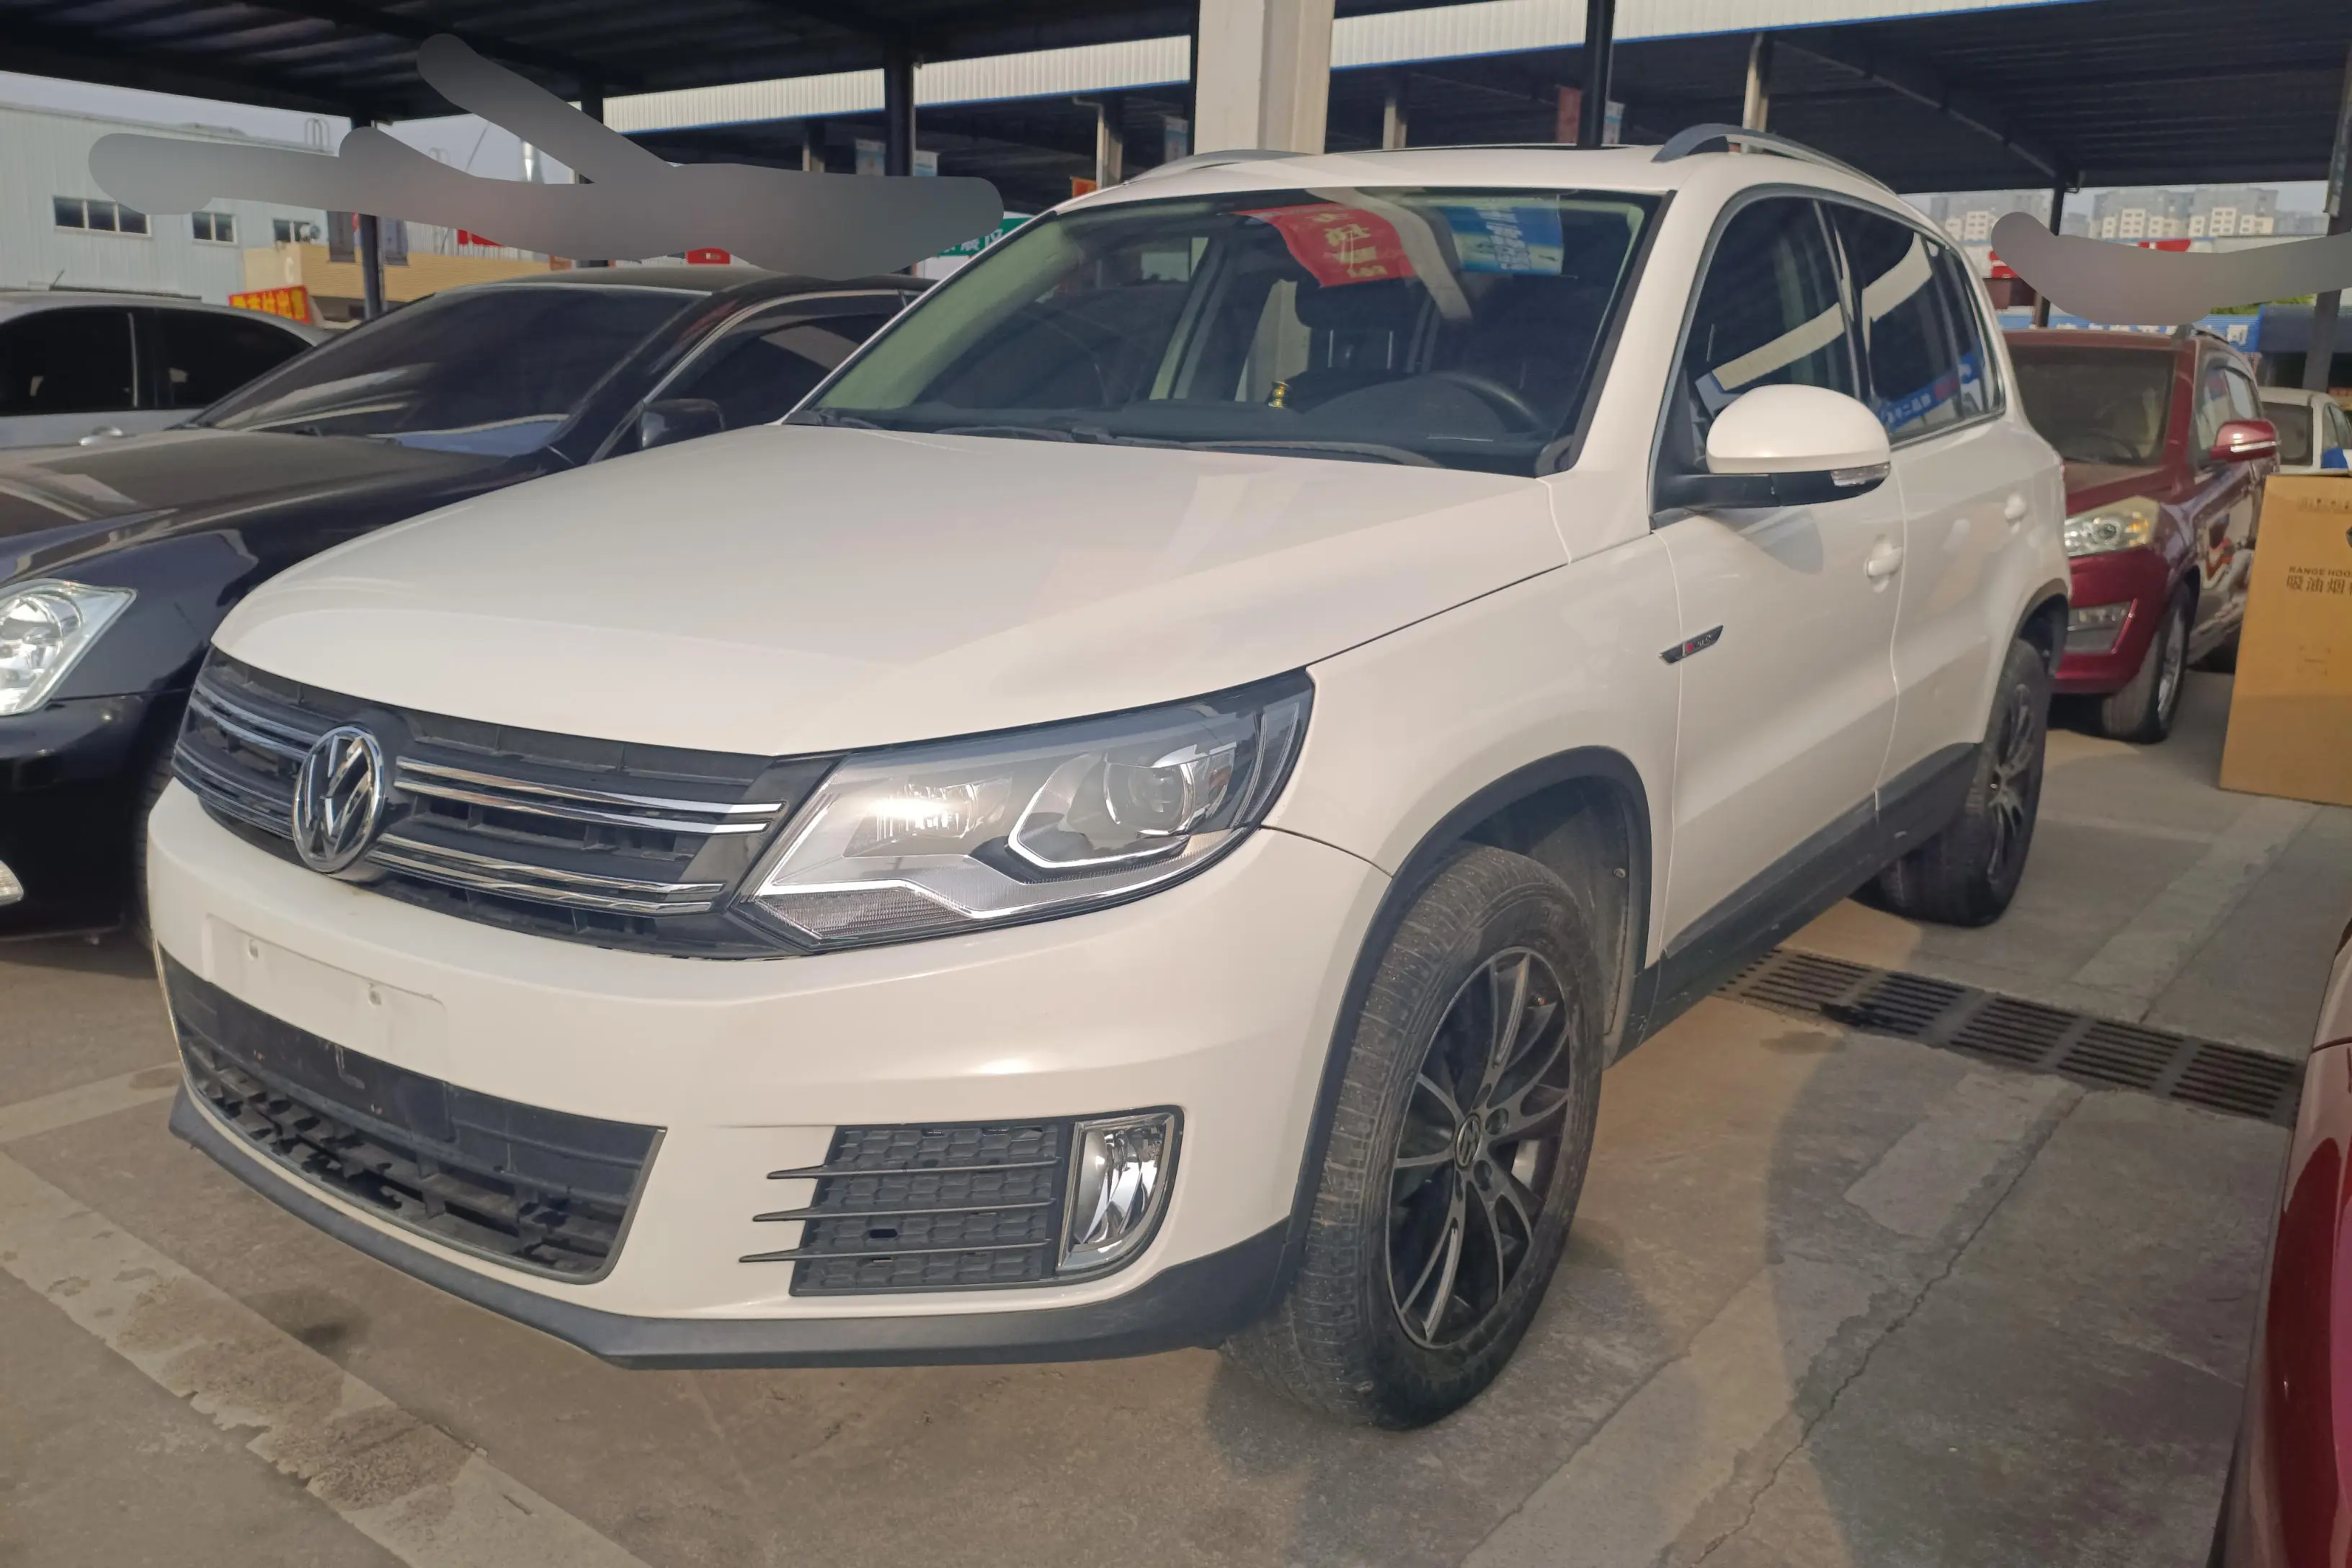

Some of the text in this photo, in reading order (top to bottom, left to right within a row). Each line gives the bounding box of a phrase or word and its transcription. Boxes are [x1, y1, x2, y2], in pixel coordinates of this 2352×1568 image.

[2289, 566, 2352, 578] RANGE HOO
[2286, 574, 2352, 596] 吸油烟
